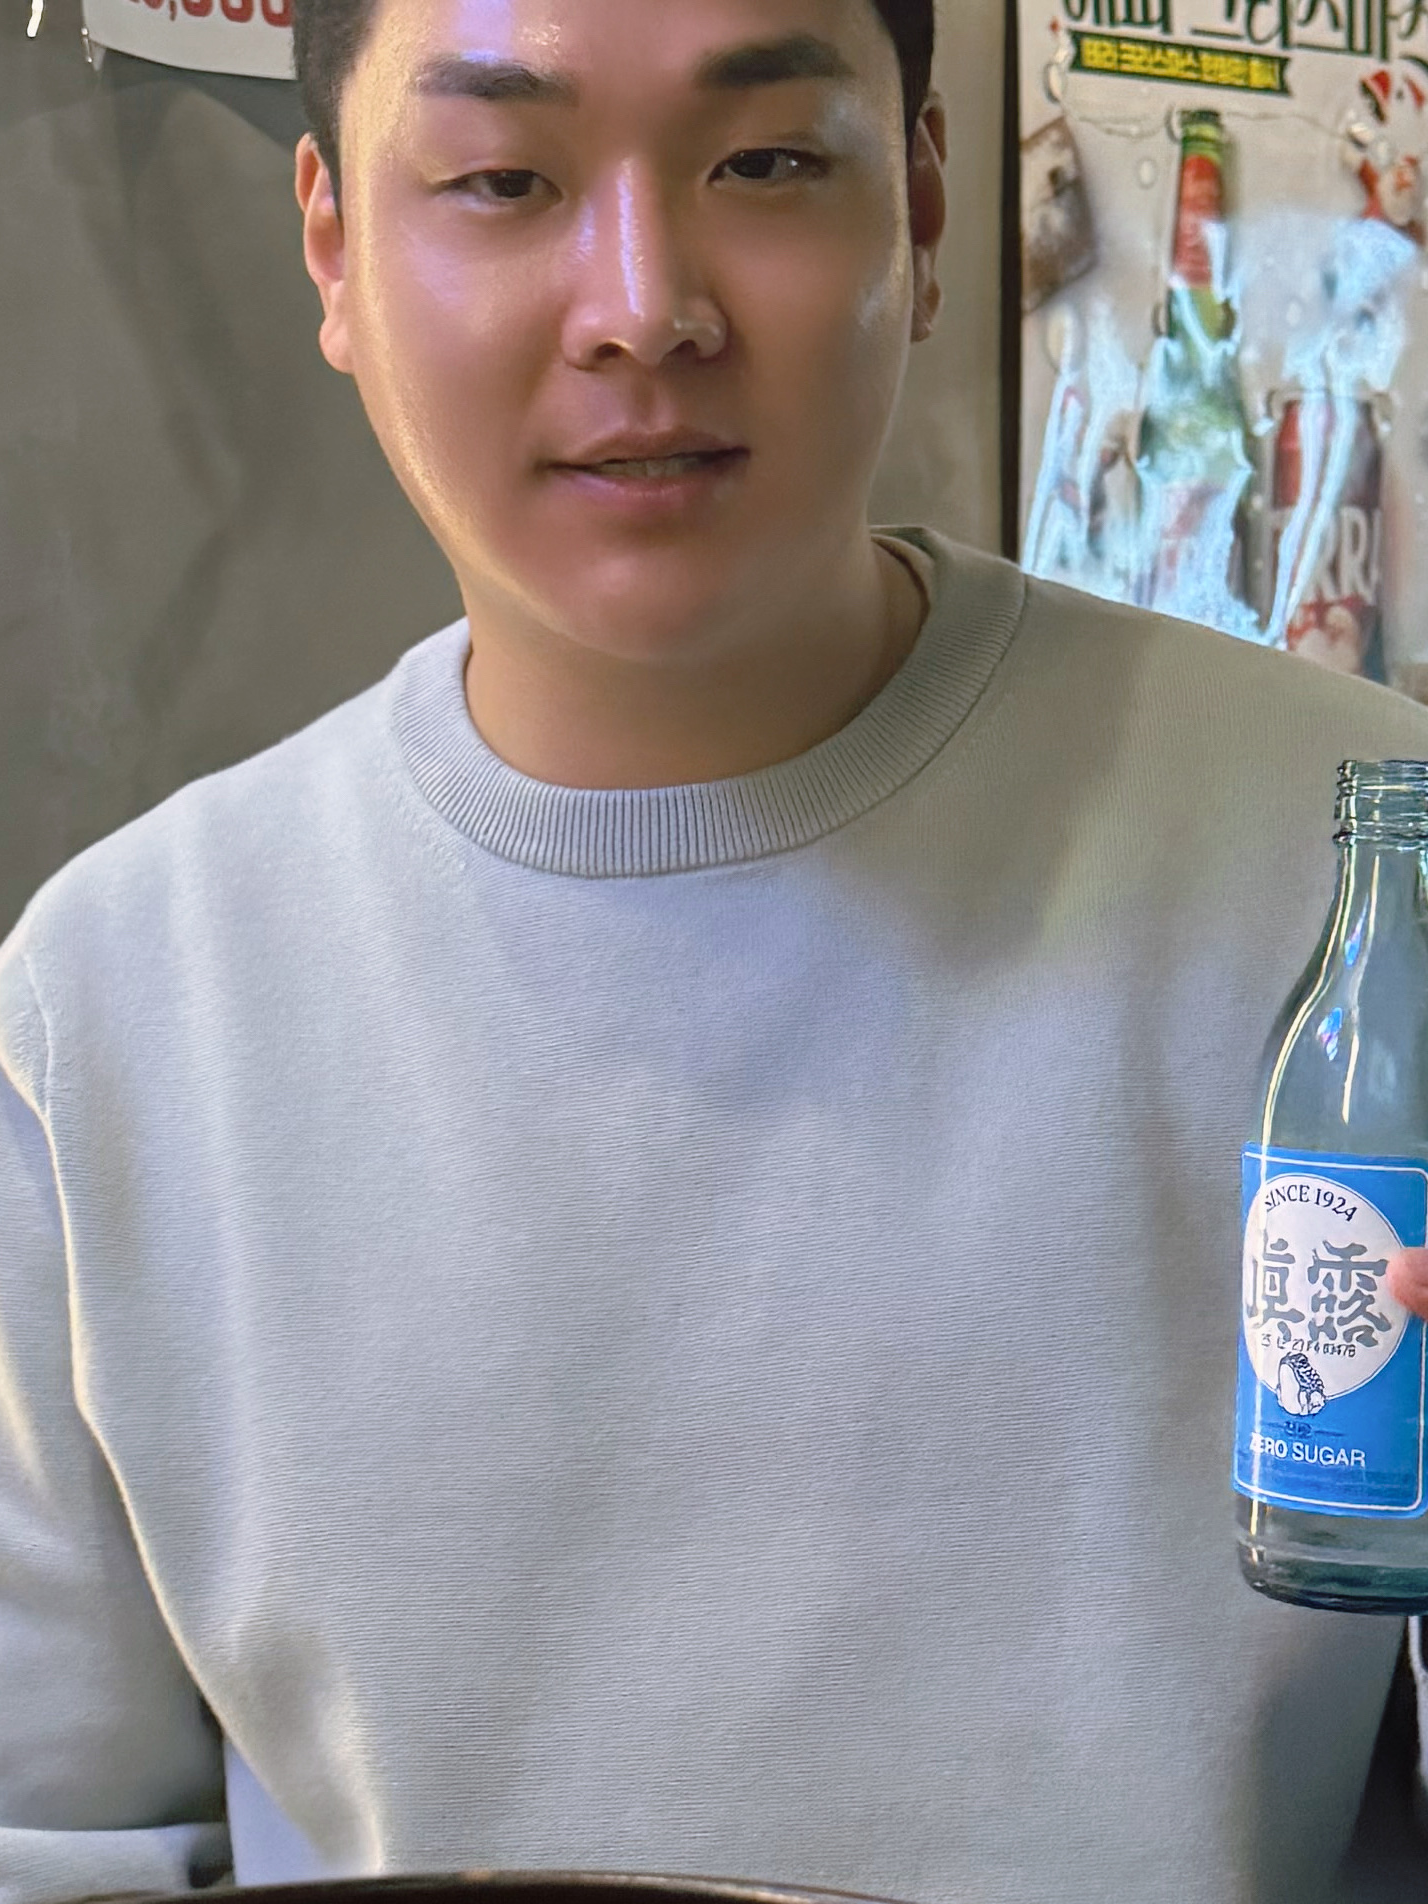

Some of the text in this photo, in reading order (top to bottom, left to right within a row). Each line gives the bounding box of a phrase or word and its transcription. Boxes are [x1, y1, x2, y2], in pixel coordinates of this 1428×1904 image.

[1265, 1184, 1358, 1222] SINCE 1924
[1250, 1432, 1367, 1468] ZERO SUGAR
